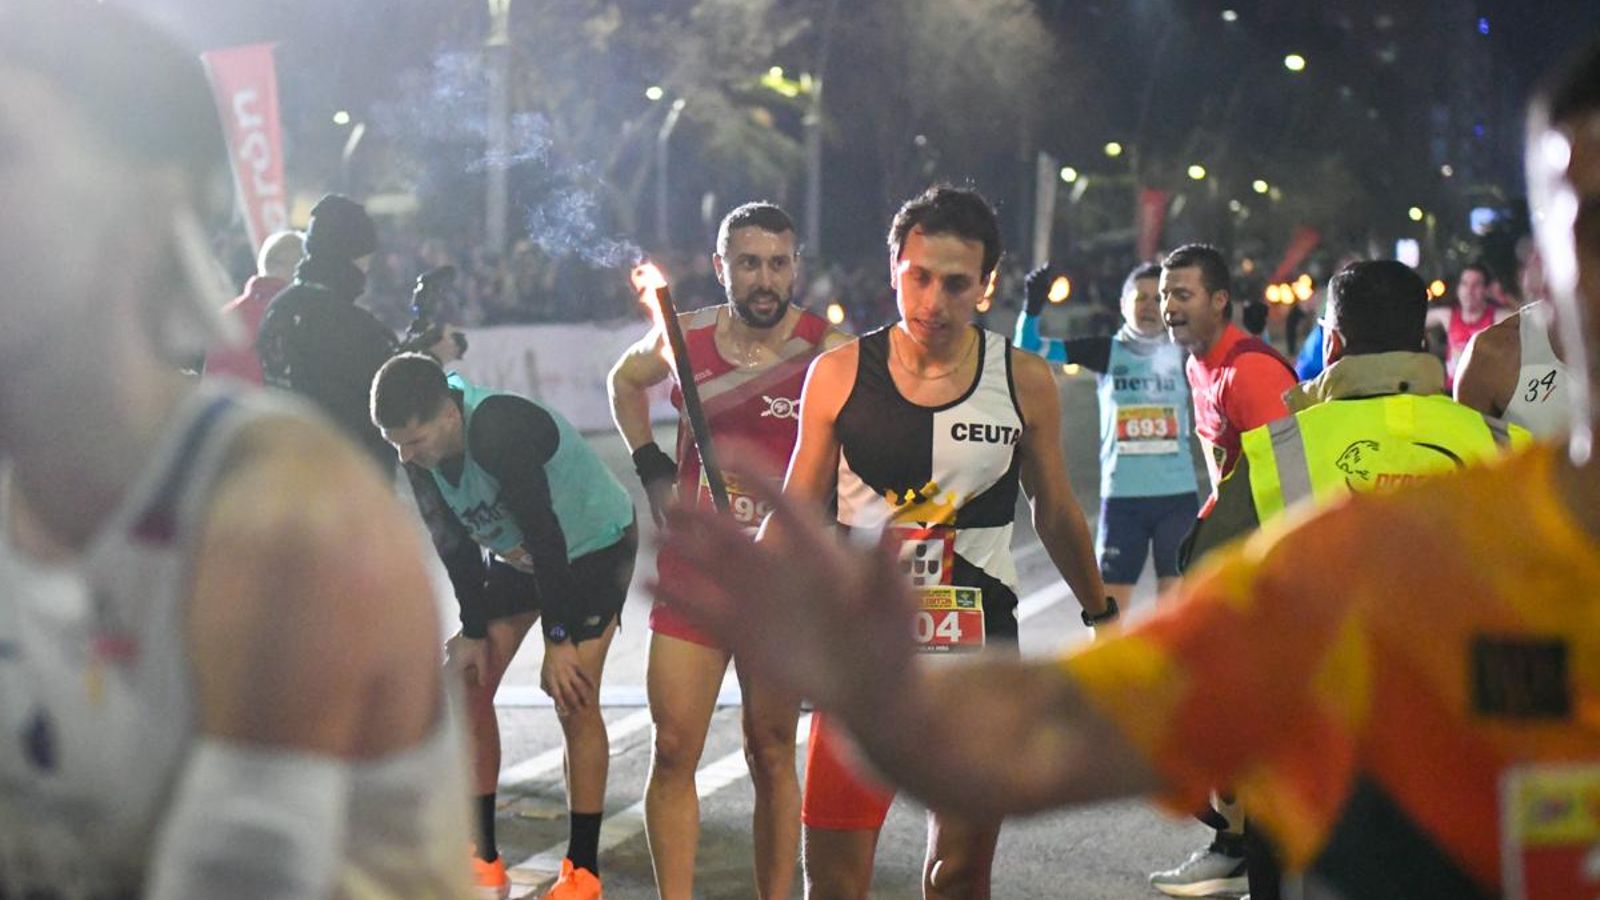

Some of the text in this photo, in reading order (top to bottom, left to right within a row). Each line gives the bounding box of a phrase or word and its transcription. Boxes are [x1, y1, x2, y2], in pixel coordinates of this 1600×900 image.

[1525, 370, 1556, 402] 34
[951, 423, 1020, 446] CEUTA
[1126, 419, 1168, 437] 693
